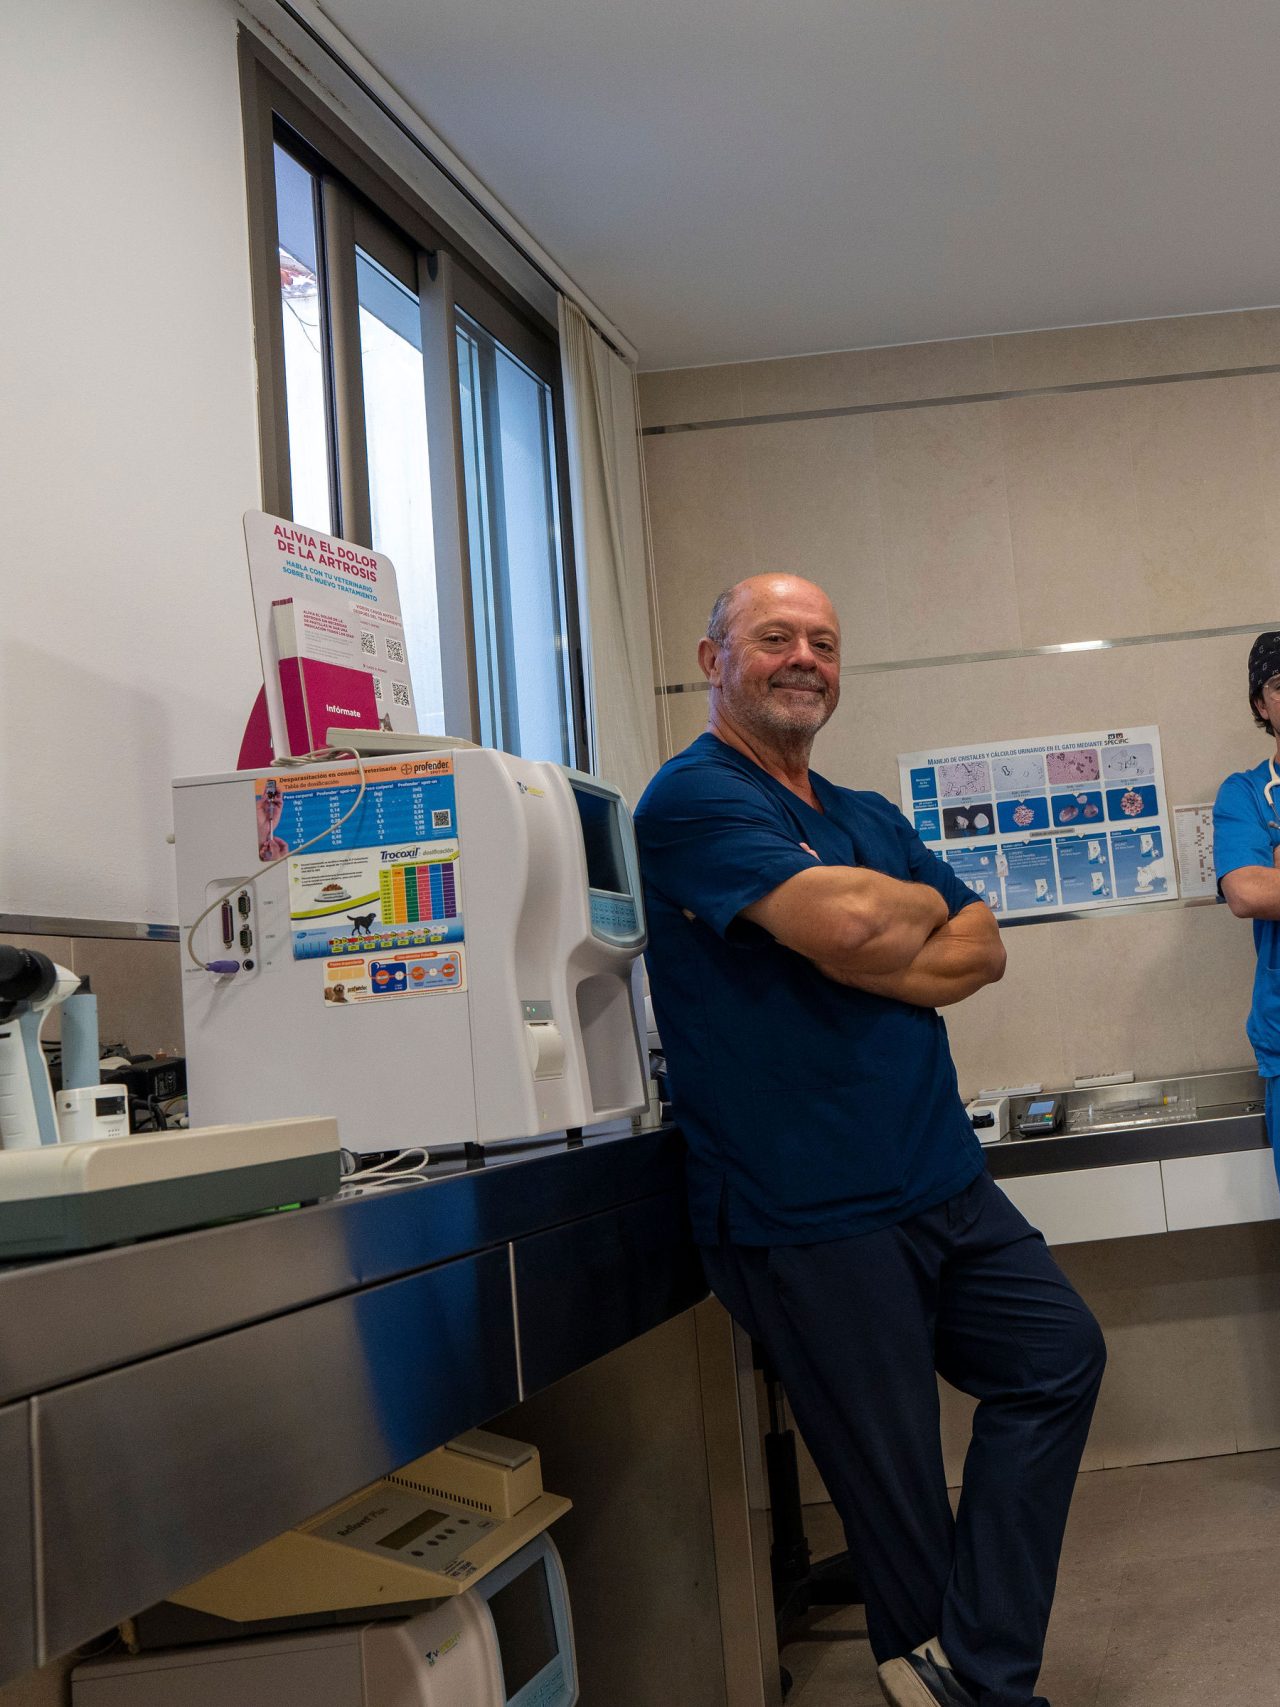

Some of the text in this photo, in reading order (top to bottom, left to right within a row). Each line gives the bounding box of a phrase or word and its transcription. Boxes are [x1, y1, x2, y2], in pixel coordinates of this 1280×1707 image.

[273, 524, 378, 570] ALIVIA EL DOLOR
[277, 539, 377, 583] DE LA ARTROSIS
[282, 566, 378, 602] SOBRE EL NUEVO TRATAMIENTO
[286, 560, 373, 593] HABLA CON TU VETERINARIO
[326, 704, 361, 718] Infórmate
[927, 757, 950, 765] MANEJO
[959, 753, 985, 761] CRISTALES
[990, 749, 1017, 758] CÁLCULOS
[1018, 747, 1046, 755] URINARIOS
[1077, 740, 1103, 748] MEDIANTE
[1104, 738, 1129, 746] SPECIFIC
[279, 772, 327, 783] Desparasitación
[337, 768, 361, 777] consult
[414, 760, 449, 774] profender
[307, 780, 340, 788] dosificación
